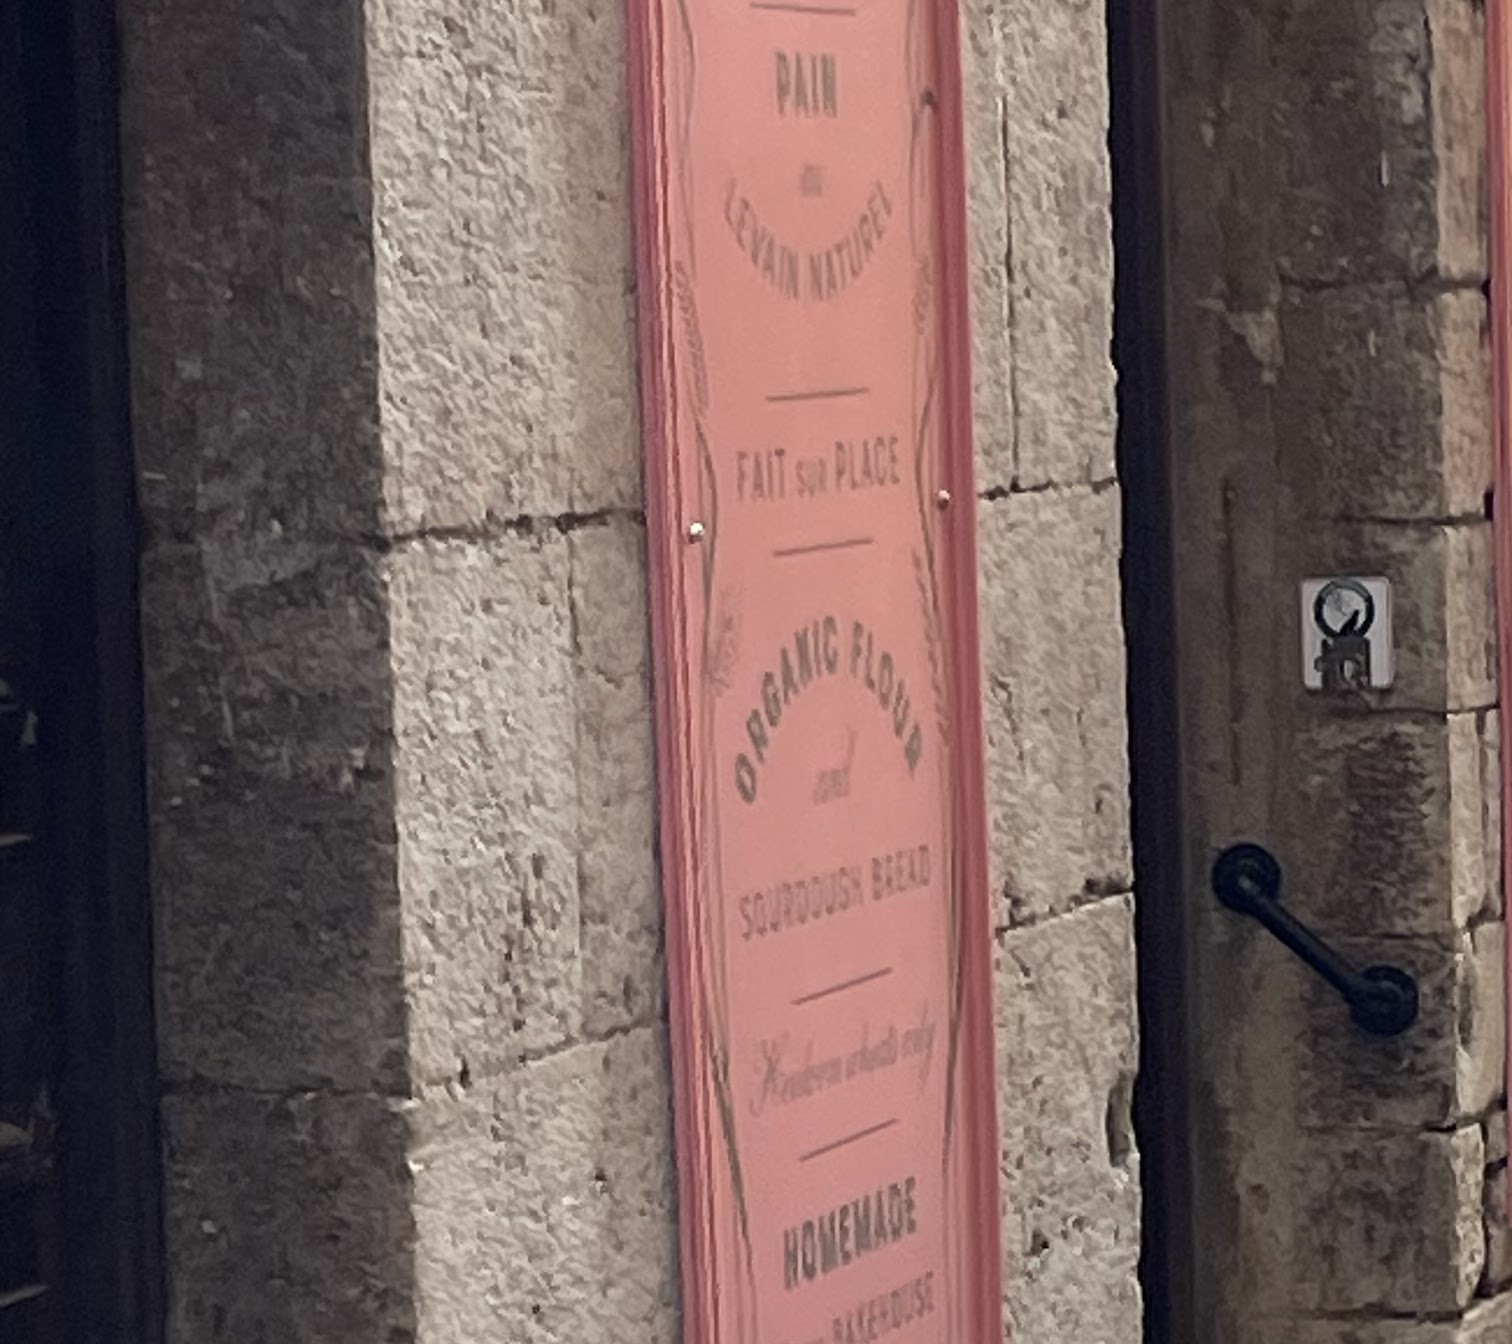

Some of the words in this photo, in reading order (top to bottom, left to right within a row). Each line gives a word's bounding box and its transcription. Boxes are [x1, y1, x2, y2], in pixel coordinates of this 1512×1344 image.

[775, 50, 839, 118] PAIN
[736, 447, 786, 502] FAIT
[834, 436, 901, 491] PLACE
[734, 615, 839, 805] ORGANIC
[850, 619, 923, 780] FLOUR
[784, 1176, 918, 1291] HOMEMADE
